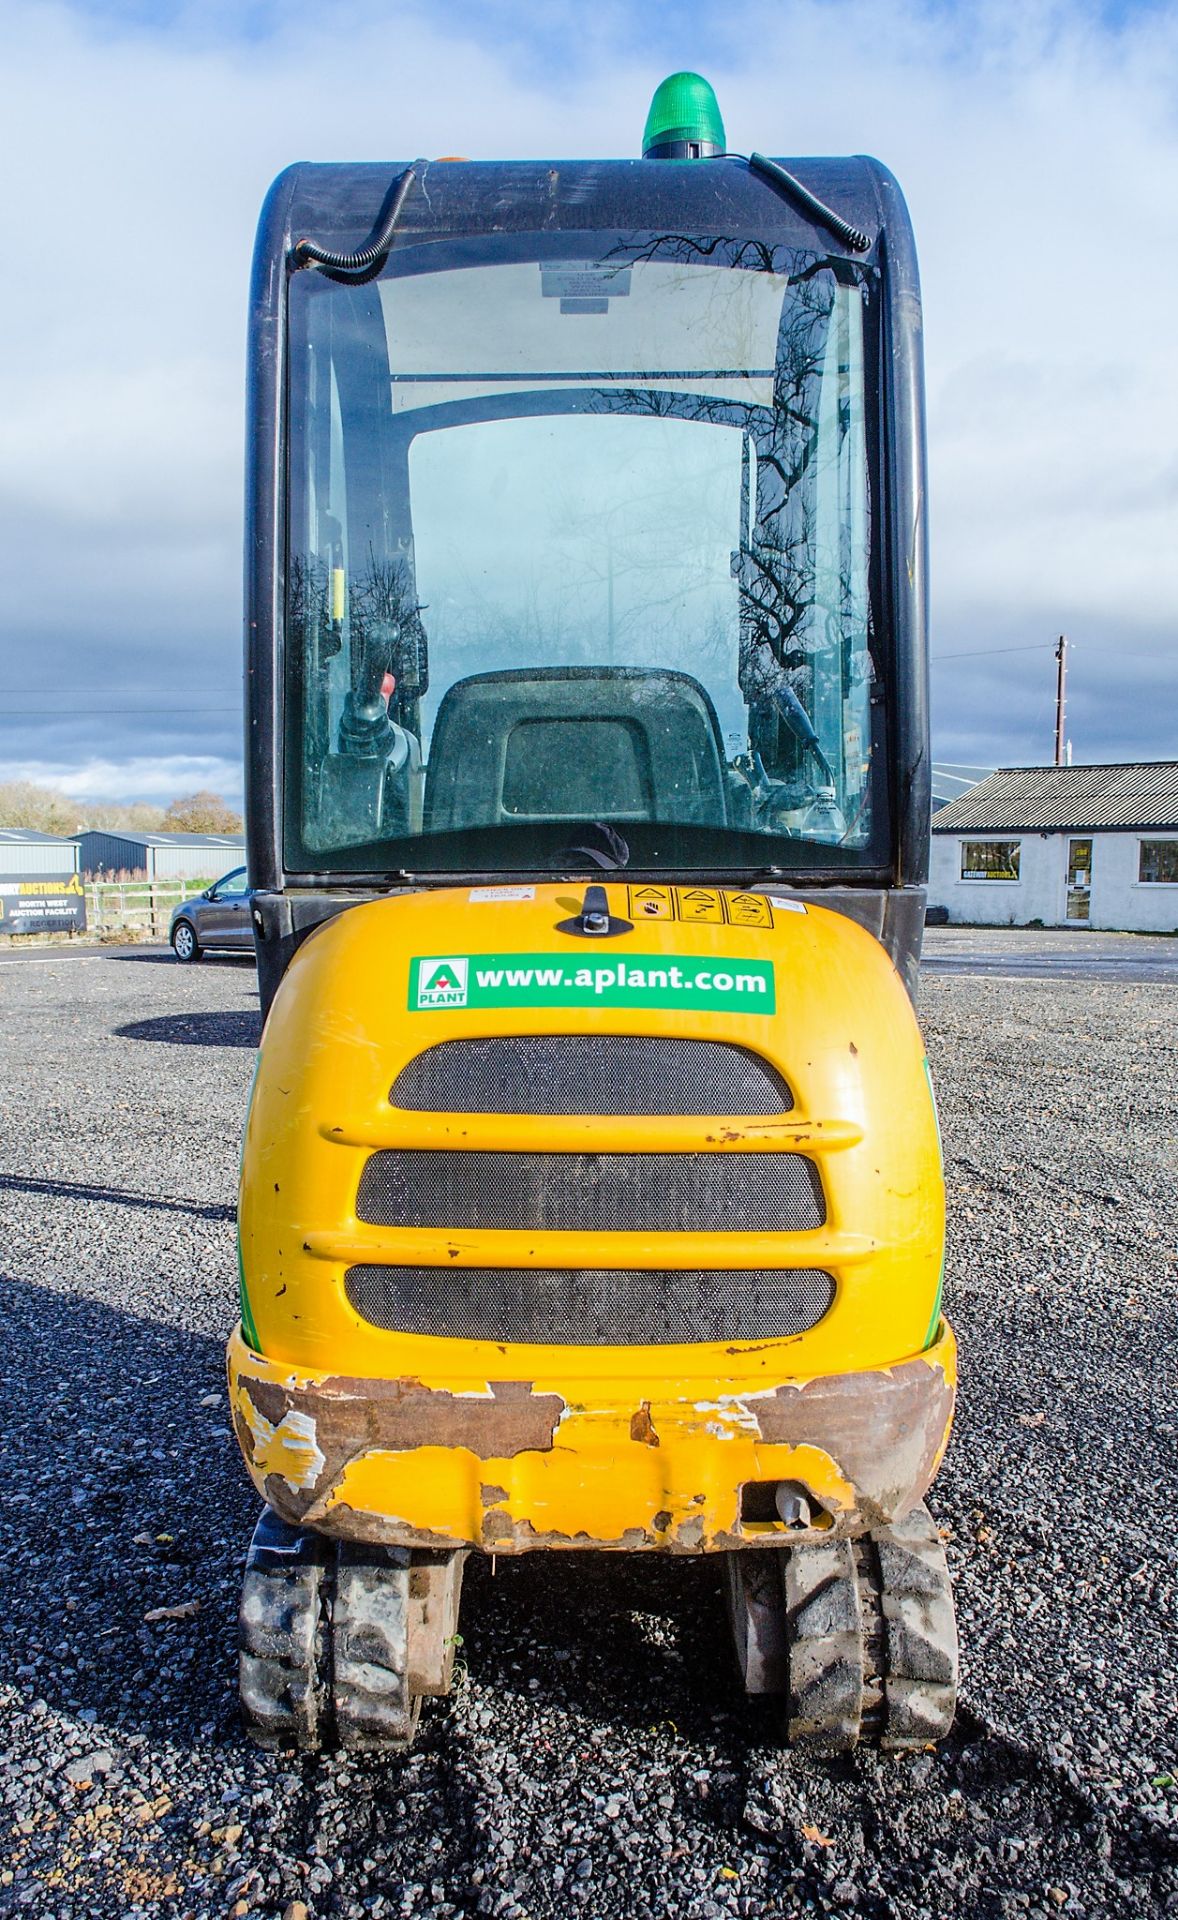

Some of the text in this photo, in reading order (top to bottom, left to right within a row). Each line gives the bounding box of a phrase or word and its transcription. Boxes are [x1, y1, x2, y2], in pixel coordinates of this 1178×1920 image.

[19, 899, 68, 908] NORTH WEST
[9, 907, 78, 917] AUCTION FACILITY
[30, 919, 79, 928] RECEPTION
[475, 963, 767, 994] www.aplant.com
[420, 993, 465, 1004] PLANT
